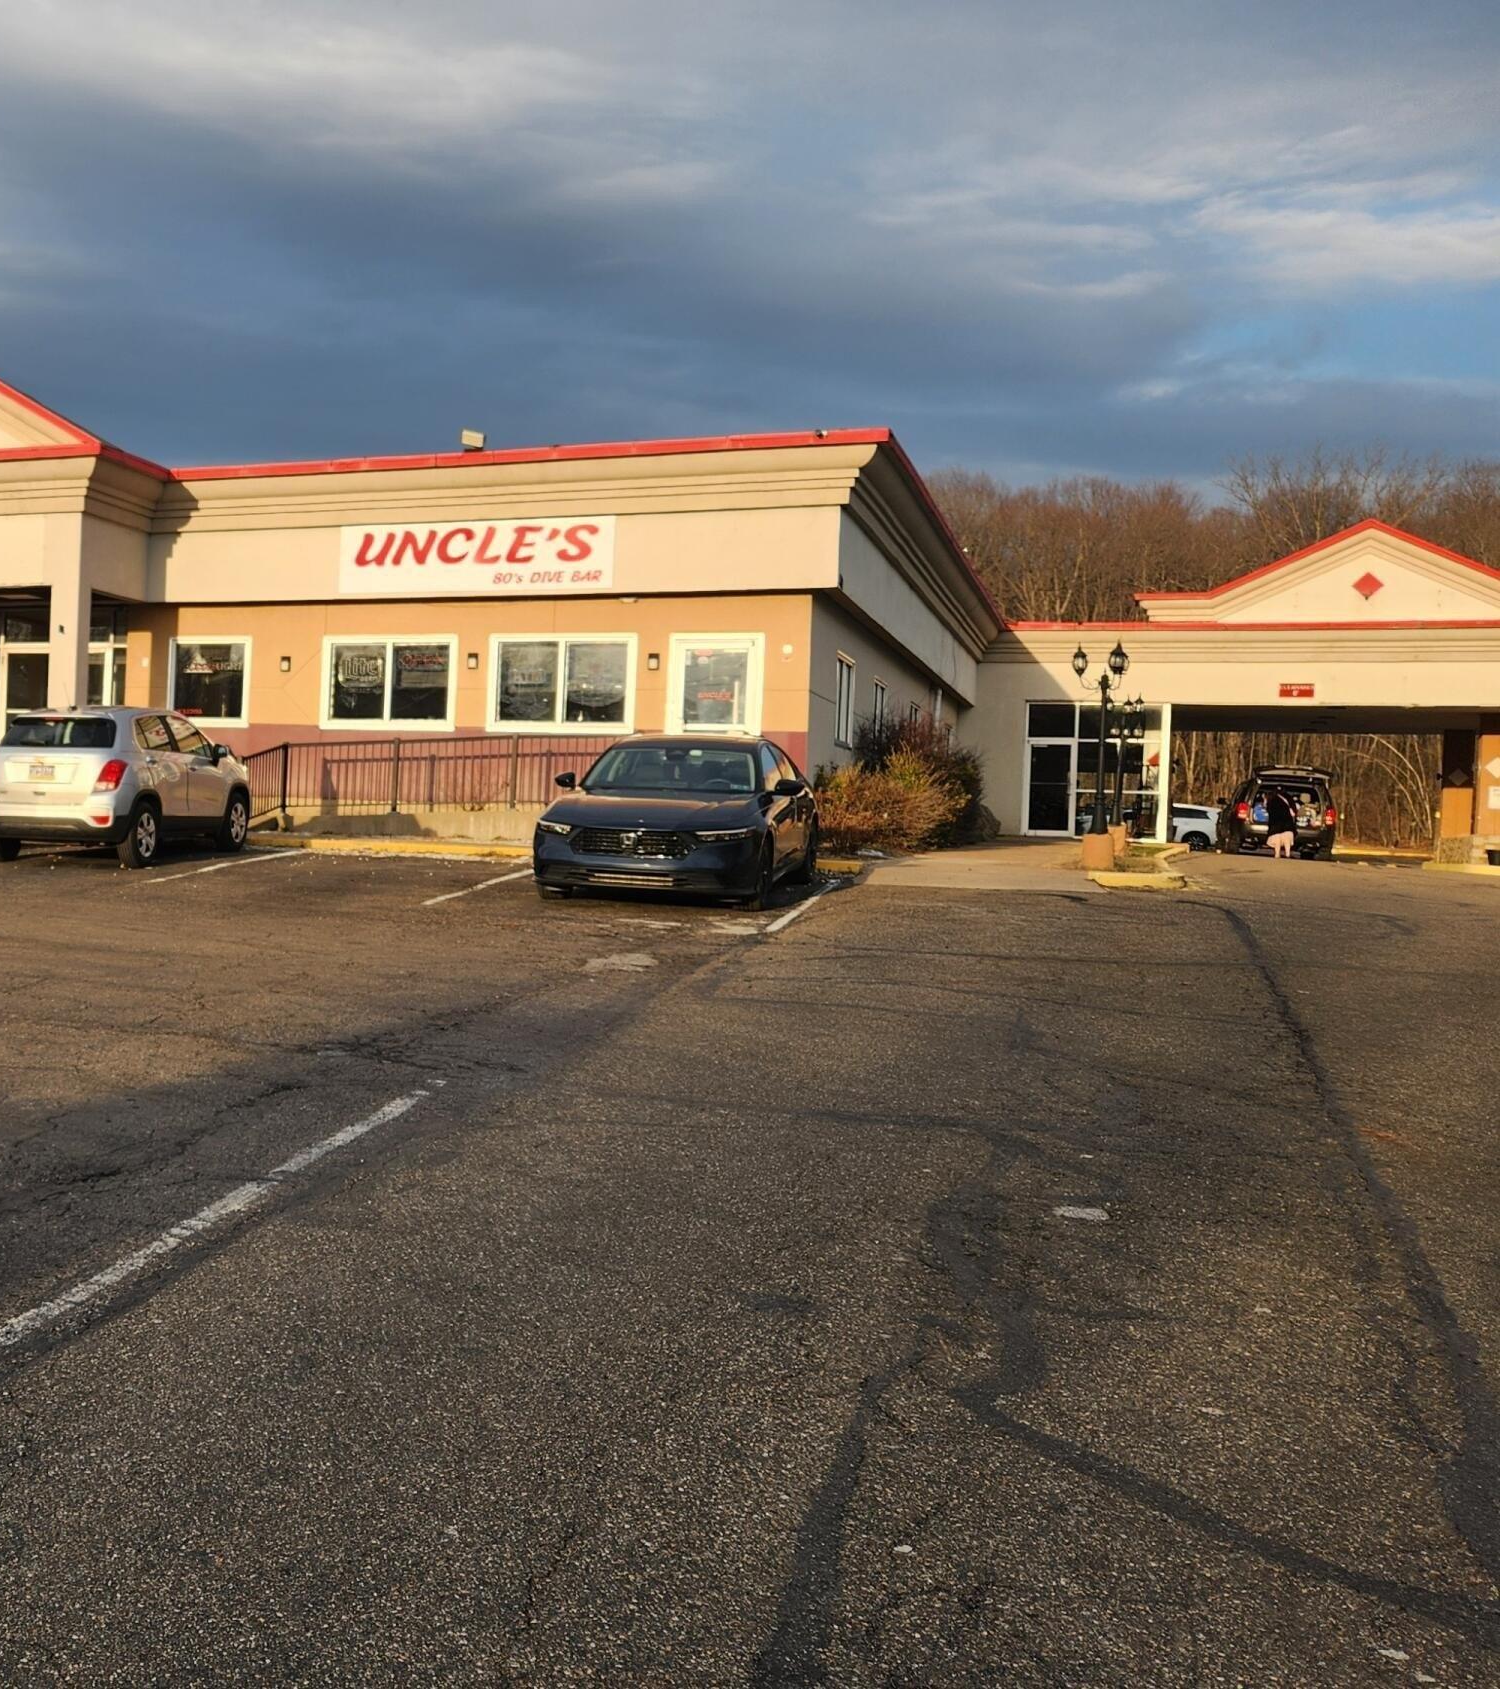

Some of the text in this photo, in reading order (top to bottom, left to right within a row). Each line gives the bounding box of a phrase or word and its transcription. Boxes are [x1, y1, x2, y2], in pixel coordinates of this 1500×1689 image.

[355, 524, 599, 566] UNCLE'S
[492, 569, 603, 585] 80's DIVE BAR
